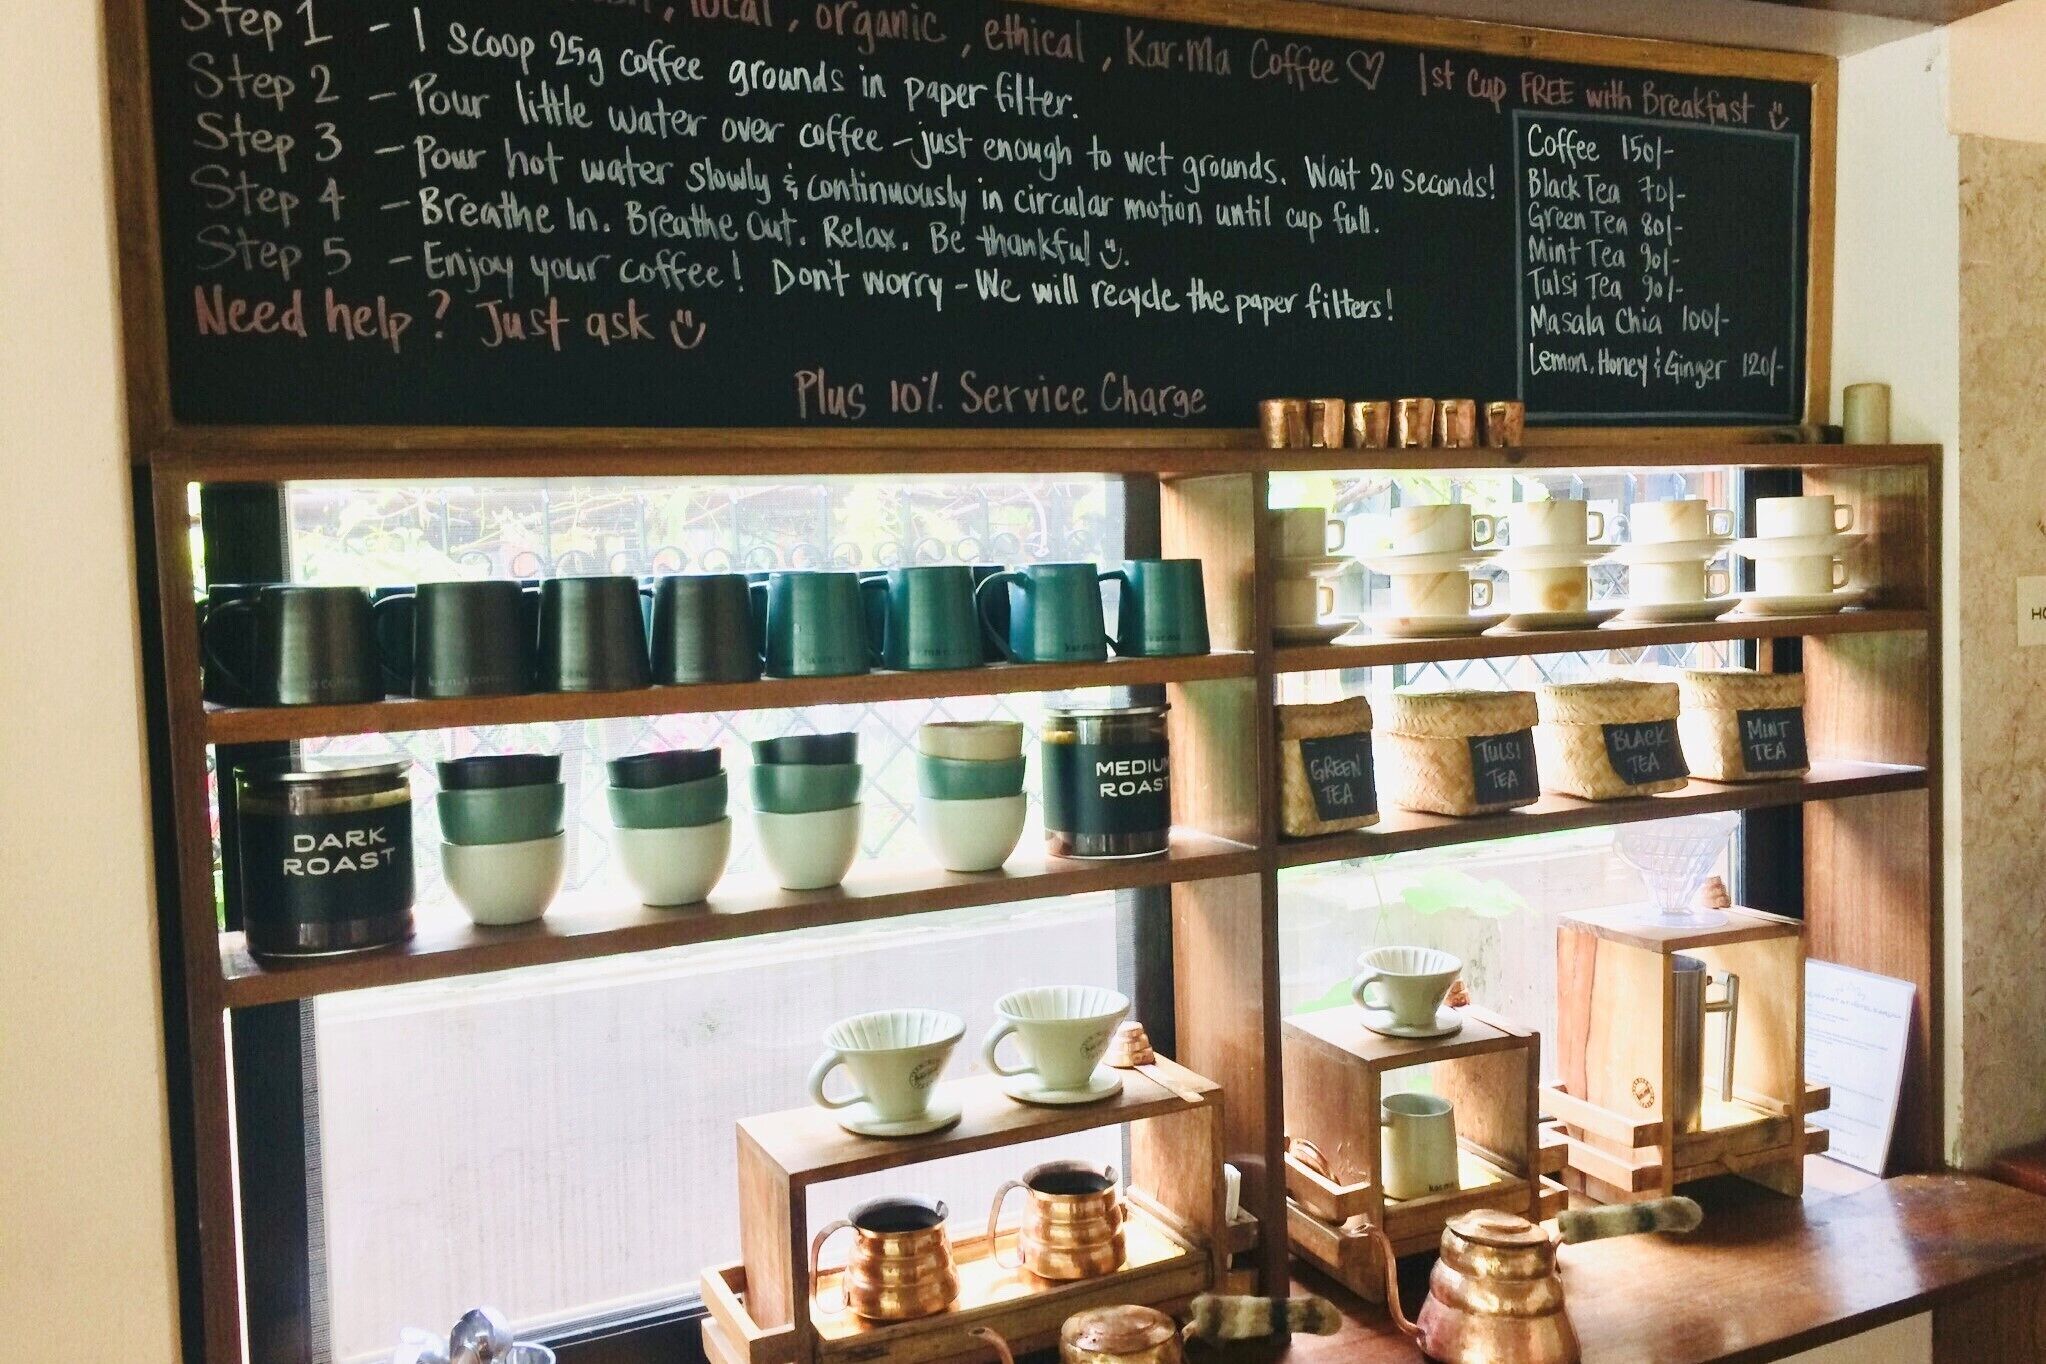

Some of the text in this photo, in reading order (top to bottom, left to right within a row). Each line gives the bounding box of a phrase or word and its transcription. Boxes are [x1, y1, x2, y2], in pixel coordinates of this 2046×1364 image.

[297, 0, 332, 46] 1
[550, 32, 604, 86] 25g
[619, 38, 703, 86] coffee
[729, 59, 845, 96] grounds
[859, 64, 887, 98] in
[905, 76, 987, 117] paper
[996, 71, 1080, 119] filter.
[816, 1, 947, 54] organic
[985, 15, 1084, 62] ethical
[1250, 38, 1338, 91] Coffee
[1521, 72, 1573, 105] FREE
[1586, 81, 1631, 111] with
[1642, 80, 1755, 124] Breakfast
[188, 52, 294, 110] Step
[311, 64, 339, 103] 2
[410, 72, 489, 119] Pour
[516, 80, 593, 129] little
[608, 96, 707, 139] water
[722, 116, 784, 144] over
[800, 113, 884, 157] coffee
[912, 120, 973, 169] just
[984, 134, 1072, 180] enough
[1086, 134, 1112, 171] to
[1124, 141, 1173, 176] wet
[1183, 151, 1286, 193] grounds.
[1304, 154, 1360, 192] Wait
[1370, 162, 1394, 191] 20
[1401, 163, 1495, 200] seconds!
[1528, 124, 1599, 170] Coffee
[194, 113, 294, 173] Step
[314, 121, 343, 162] 3
[414, 134, 486, 179] Pour
[504, 137, 564, 184] hot
[581, 145, 673, 187] water
[806, 167, 967, 225] continuously
[977, 177, 1003, 211] in
[1014, 185, 1120, 217] circular
[1124, 193, 1203, 226] motion
[1216, 193, 1270, 227] until
[1286, 208, 1321, 243] cup
[1333, 201, 1380, 235] full.
[1528, 168, 1580, 201] Black
[1583, 173, 1621, 204] Tea
[190, 163, 300, 228] Step
[318, 177, 345, 221] 4
[419, 186, 556, 234] Breathe
[627, 199, 738, 241] Breathe
[823, 216, 909, 252] Relax.
[930, 221, 965, 255] Be
[977, 224, 1091, 267] thankful
[1527, 203, 1587, 232] Green
[1590, 209, 1628, 237] Tea
[1528, 236, 1582, 267] Mint
[1588, 238, 1626, 269] Tea
[196, 225, 301, 282] Step
[323, 236, 352, 275] 5
[423, 240, 514, 299] Enjoy
[531, 253, 612, 297] your
[863, 269, 943, 312] worry
[975, 267, 1020, 303] We
[1031, 274, 1079, 306] will
[1091, 278, 1180, 318] recycle
[1186, 276, 1229, 313] the
[1236, 288, 1299, 327] paper
[1305, 282, 1393, 321] filters!
[1527, 267, 1578, 302] Tulsi
[1587, 273, 1623, 302] Tea
[195, 284, 306, 337] Need
[475, 297, 569, 352] Just
[586, 297, 655, 346] ask
[1531, 304, 1605, 337] Masala
[1615, 307, 1663, 336] Chia
[1597, 352, 1648, 388] Honey
[1664, 350, 1727, 389] Ginger
[794, 367, 1207, 419] Plus 10% Service Charge
[1611, 725, 1669, 752] BLACK
[1751, 741, 1787, 761] TEA
[1310, 752, 1362, 782] GREEN
[1486, 768, 1519, 790] TEA
[1627, 753, 1660, 774] TEA
[1321, 783, 1354, 806] TEA
[293, 827, 387, 853] DARK
[283, 846, 395, 876] ROAST
